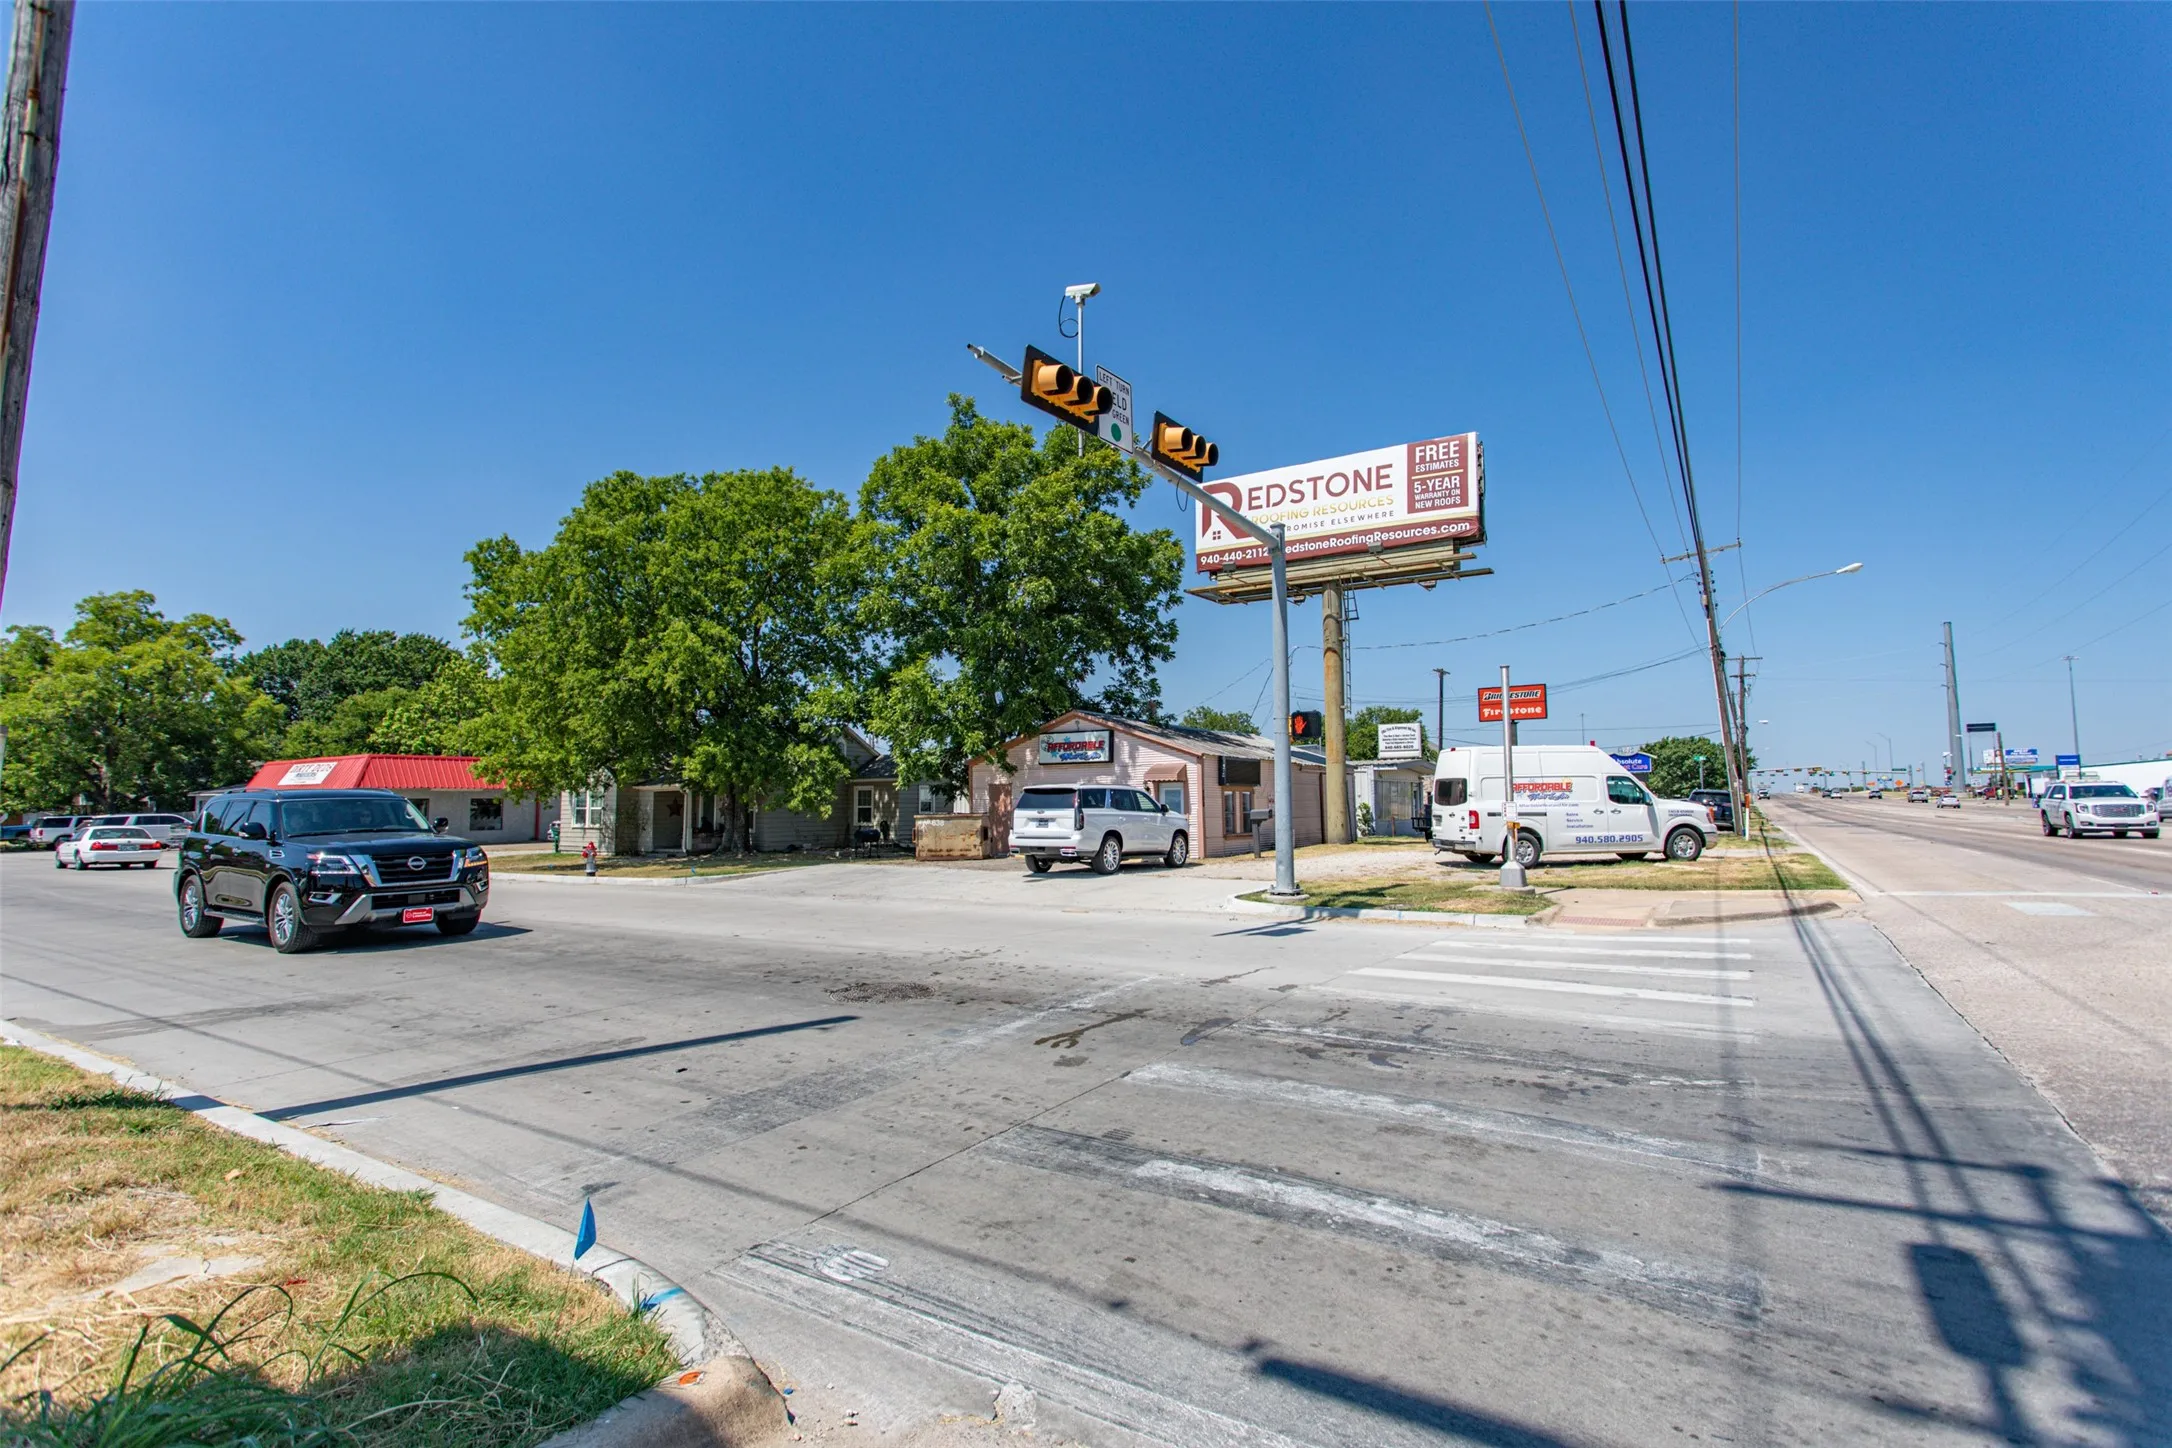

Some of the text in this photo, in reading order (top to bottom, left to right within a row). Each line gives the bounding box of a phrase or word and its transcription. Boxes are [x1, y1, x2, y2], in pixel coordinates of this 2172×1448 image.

[1099, 371, 1130, 396] LEFT TURN
[1112, 391, 1127, 411] ELD
[1112, 408, 1130, 426] GREEN
[1415, 441, 1460, 463] FREE
[1415, 459, 1459, 473] ESTIMATES
[1414, 476, 1460, 493] 5-YEAR
[1414, 487, 1461, 501] WARRANTY ON
[1251, 495, 1394, 526] ROOFING RESOURCES
[1415, 496, 1461, 509] NEW ROOFS
[1331, 510, 1394, 526] ELSEWHERE
[1200, 521, 1470, 565] 940-440-2112 edstoneRoofingResources.com
[1047, 739, 1105, 753] AFFORDABLE
[1513, 782, 1573, 793] AFFORDABLE
[1575, 834, 1644, 844] 940.580.2905
